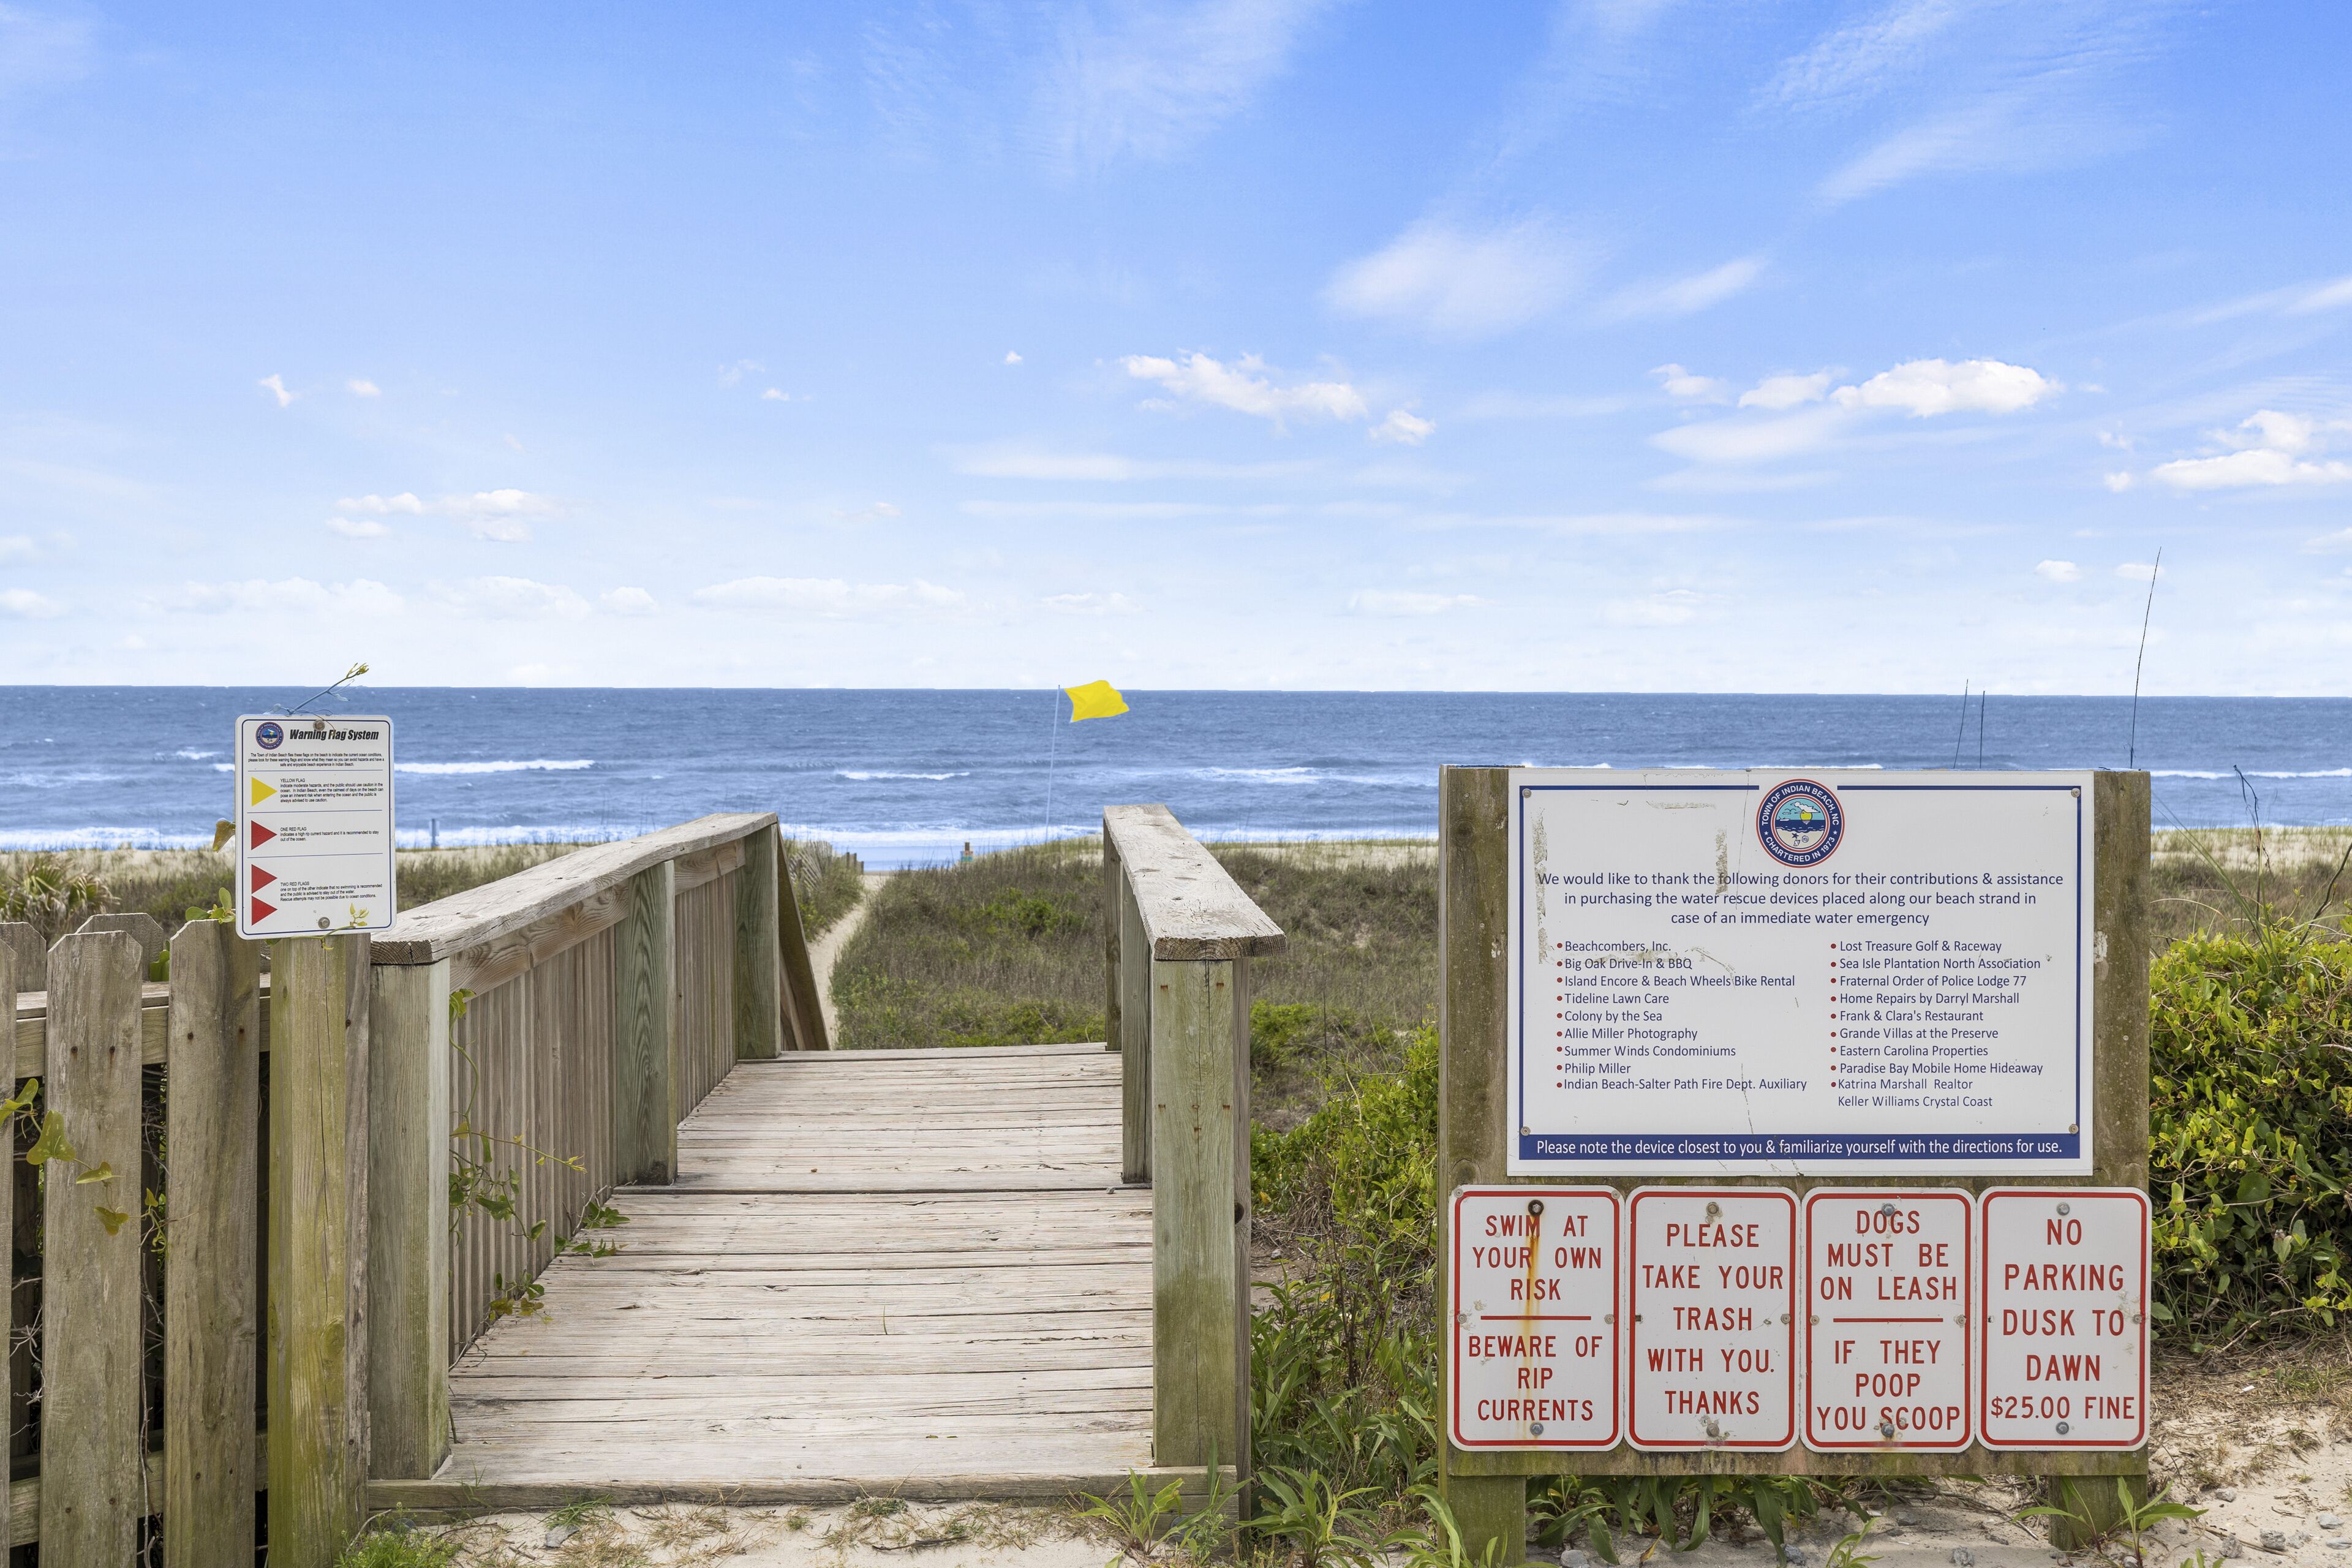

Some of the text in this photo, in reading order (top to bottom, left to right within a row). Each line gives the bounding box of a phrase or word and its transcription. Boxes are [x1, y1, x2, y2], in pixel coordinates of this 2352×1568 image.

[290, 730, 379, 741] Warning Flag System
[1762, 785, 1839, 826] TOWN OF INDIAN BEACH, NC
[1766, 837, 1835, 862] CHARTERED IN 1973
[1538, 873, 2063, 887] We would like to thank the following donors for their contributions & assistance
[1565, 892, 2036, 907] in purchasing the water rescue devices placed along our beach strand in
[1704, 912, 1717, 923] of
[1741, 912, 1811, 923] immediate
[1815, 913, 1853, 923] water
[1857, 915, 1929, 926] emergency
[1565, 941, 1671, 953] Beachcombers, Inc.
[1841, 940, 2001, 953] Lost Treasure Golf & Raceway
[1566, 956, 1692, 971] Big Oak Drive-In & BBQ
[1840, 958, 2040, 968] Sea Isle Plantation North Association
[1566, 975, 1794, 986] Island Encore & Beach Wheels Bike Rental
[1841, 975, 2026, 988] Fraternal Order of Police Lodge 77
[1565, 993, 1669, 1003] Tideline Lawn Care
[1839, 1079, 1973, 1089] Katrina Marshall Realtor
[1538, 1139, 2062, 1156] Please note the device closest to you & familiarize yourself with the directions for use.
[1485, 1215, 1588, 1236] SWIM AT
[1857, 1210, 1920, 1234] DOGS
[2048, 1219, 2081, 1245] NO
[1667, 1224, 1758, 1247] PLEASE
[1472, 1247, 1601, 1268] YOUR OWN
[1828, 1244, 1948, 1267] MUST BE
[1642, 1265, 1783, 1289] TAKE YOUR
[1821, 1276, 1956, 1301] ON LEASH
[2005, 1264, 2123, 1291] PARKING
[1511, 1278, 1560, 1301] RISK
[1674, 1307, 1751, 1330] TRASH
[2003, 1309, 2124, 1336] DUSK TO
[1469, 1336, 1602, 1358] BEWARE OF
[1835, 1340, 1940, 1364] IF THEY
[1648, 1349, 1773, 1372] WITH YOU.
[2027, 1355, 2099, 1381] DAWN
[1518, 1367, 1552, 1389] RIP
[1856, 1373, 1920, 1397] POOP
[1478, 1399, 1592, 1421] CURRENTS
[1666, 1391, 1759, 1414] THANKS
[1992, 1396, 2134, 1419] $25.00 FINE
[1818, 1406, 1959, 1430] YOU SCOOP
